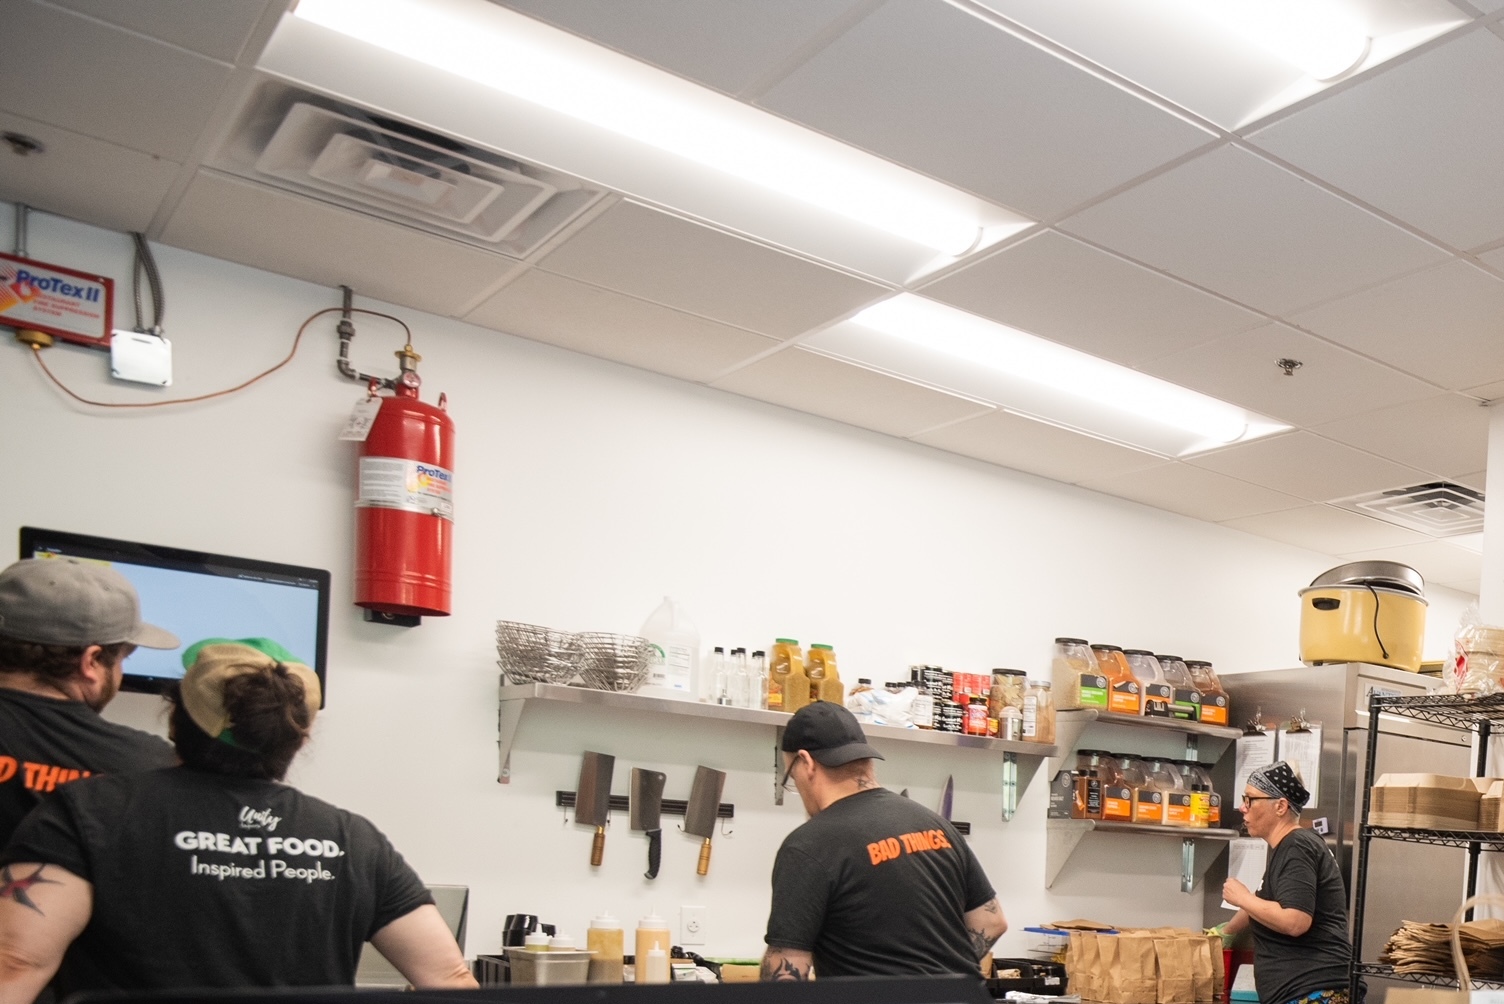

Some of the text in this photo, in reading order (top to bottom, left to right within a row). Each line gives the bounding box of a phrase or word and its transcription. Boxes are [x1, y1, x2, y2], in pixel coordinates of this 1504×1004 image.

[16, 269, 84, 299] ProTex
[238, 806, 282, 831] Unity
[174, 831, 262, 855] GREAT
[866, 829, 952, 866] BAD THINGS
[191, 855, 335, 884] Inspired People.
